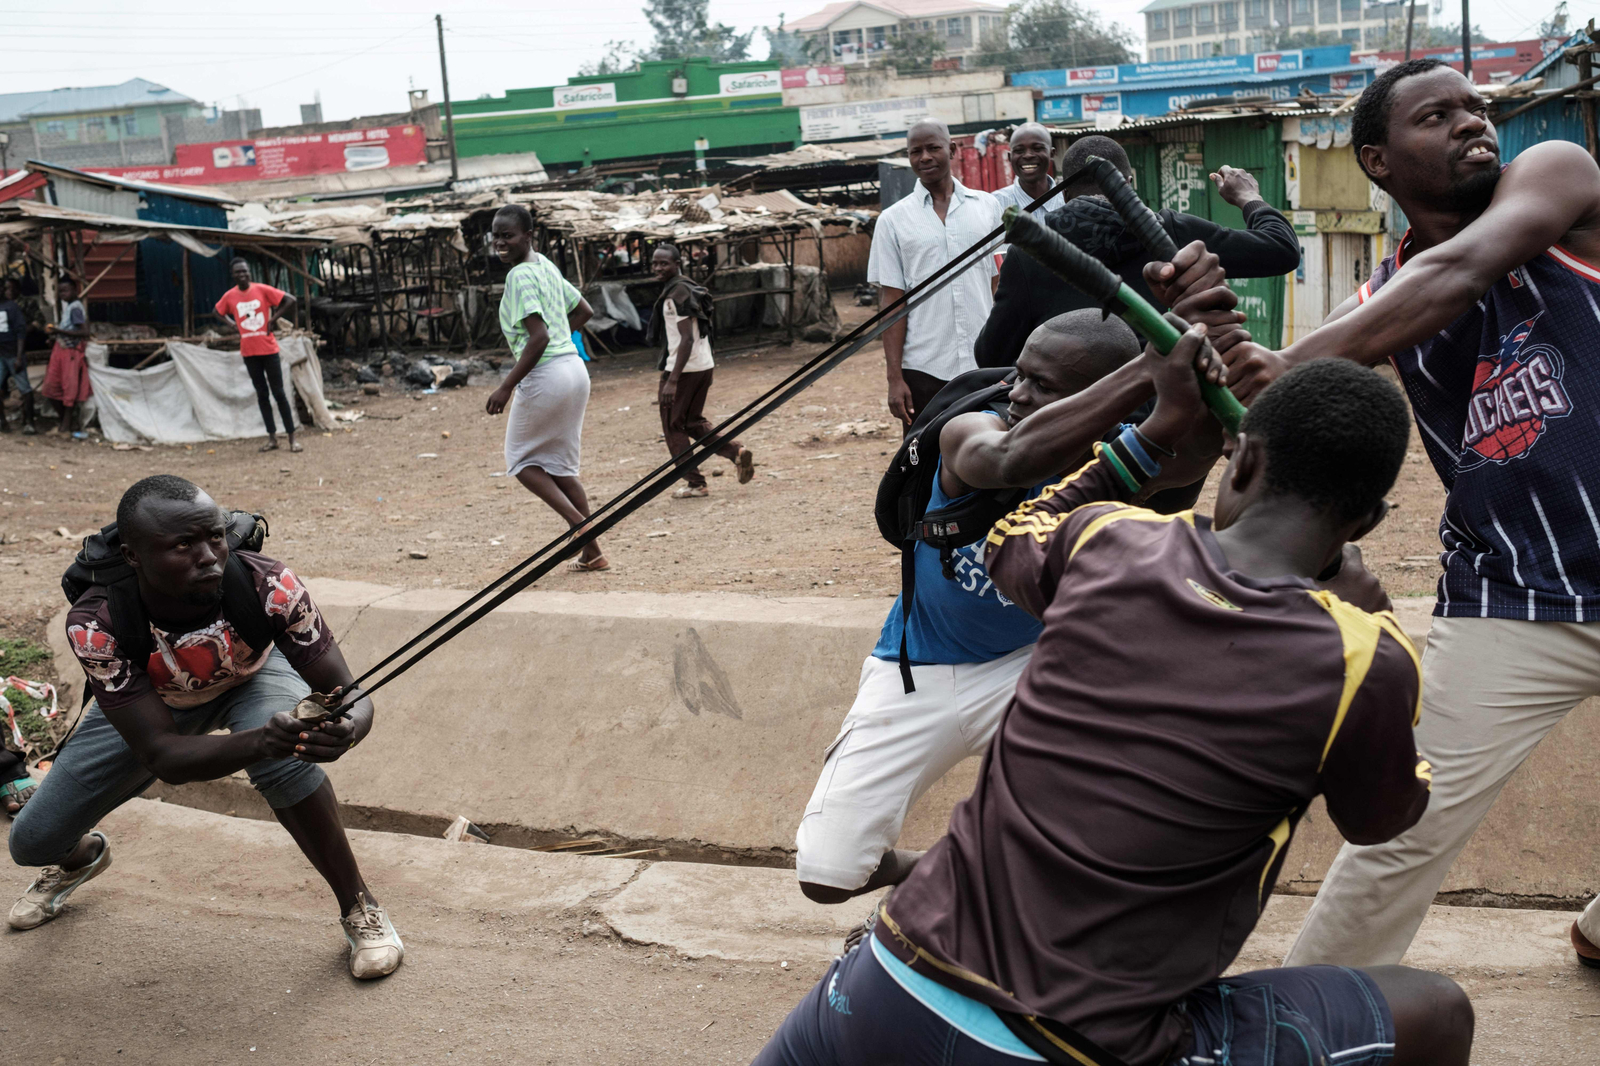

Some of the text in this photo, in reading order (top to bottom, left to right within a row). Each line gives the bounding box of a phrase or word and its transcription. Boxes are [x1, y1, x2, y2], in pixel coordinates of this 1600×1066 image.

[1260, 58, 1296, 70] ktn NEWS
[1077, 69, 1094, 79] ktn
[1095, 70, 1112, 79] NEWS
[731, 78, 778, 90] Safaricom
[563, 90, 613, 104] Safaricom
[1084, 98, 1099, 109] ktn
[163, 166, 205, 178] BUTCHERY
[1462, 356, 1568, 450] OCKETS
